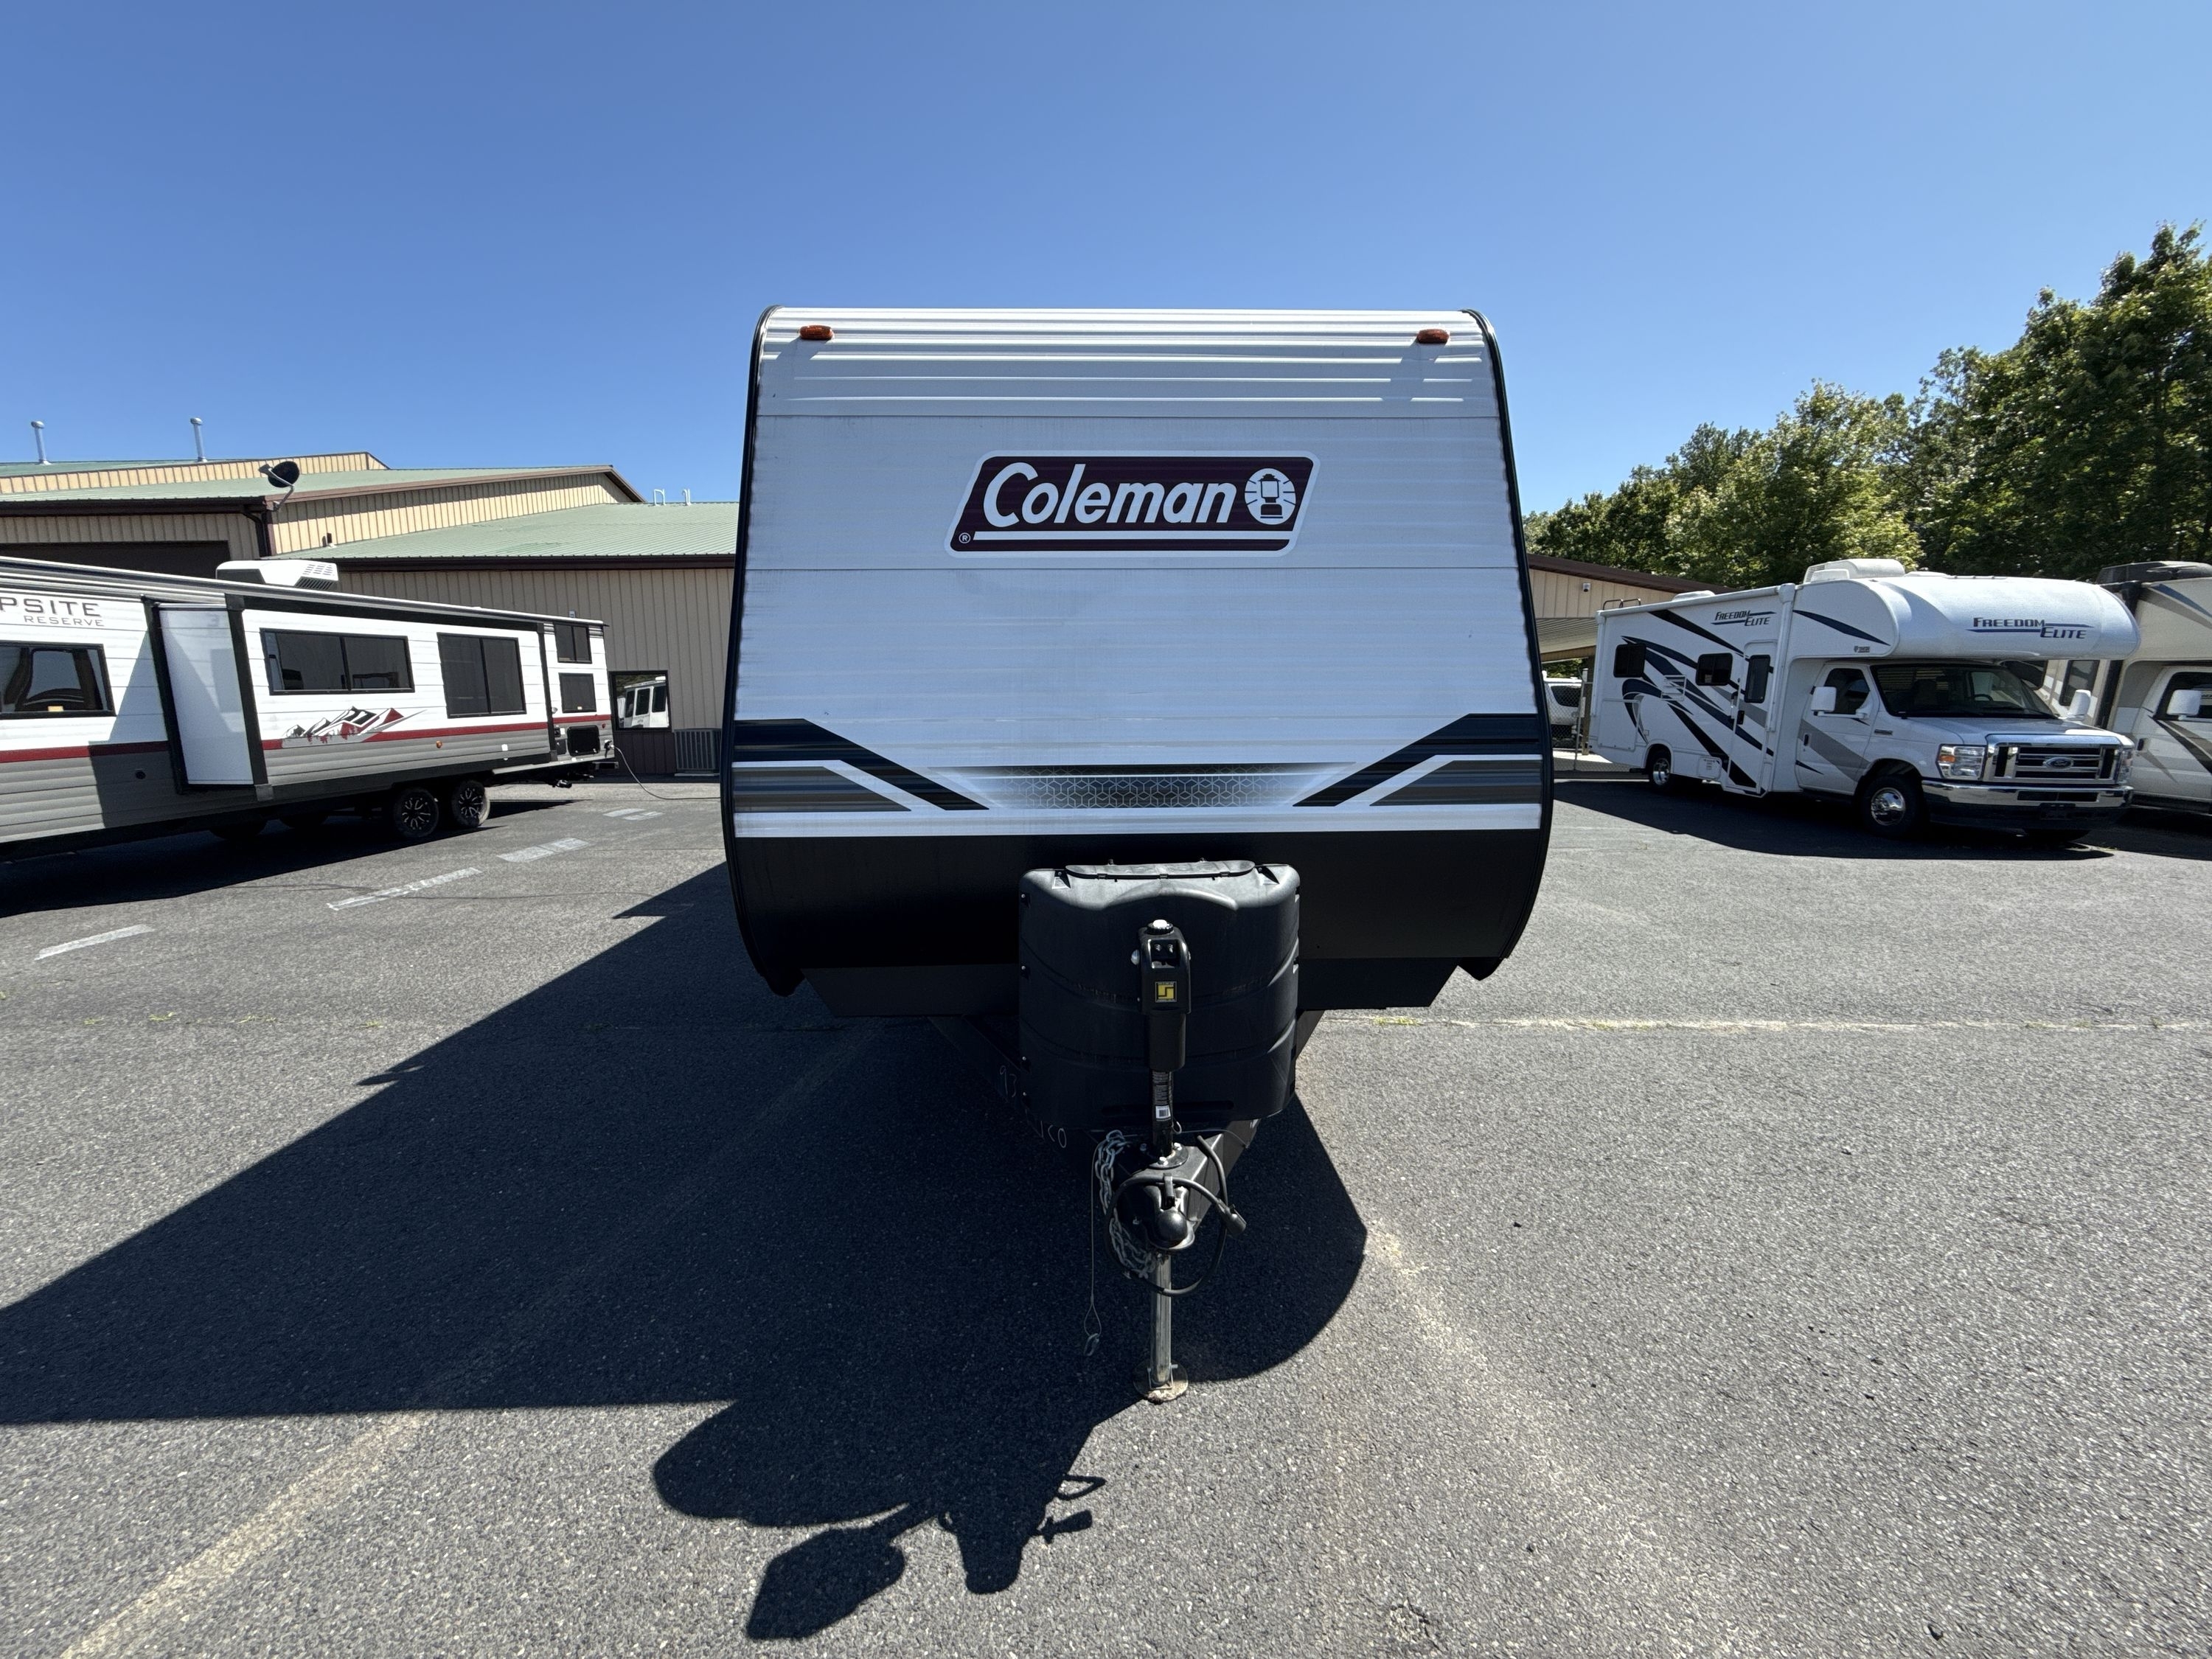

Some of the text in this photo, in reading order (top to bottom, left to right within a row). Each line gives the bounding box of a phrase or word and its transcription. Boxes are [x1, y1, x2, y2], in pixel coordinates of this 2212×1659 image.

[983, 462, 1237, 528] Coleman
[0, 596, 102, 617] PSITE
[23, 615, 105, 627] RESERVE
[1714, 610, 1751, 621] FREEDOM
[1744, 616, 1771, 627] ELITE
[1973, 617, 2045, 627] FREEDOM
[2039, 627, 2087, 639] ELITE
